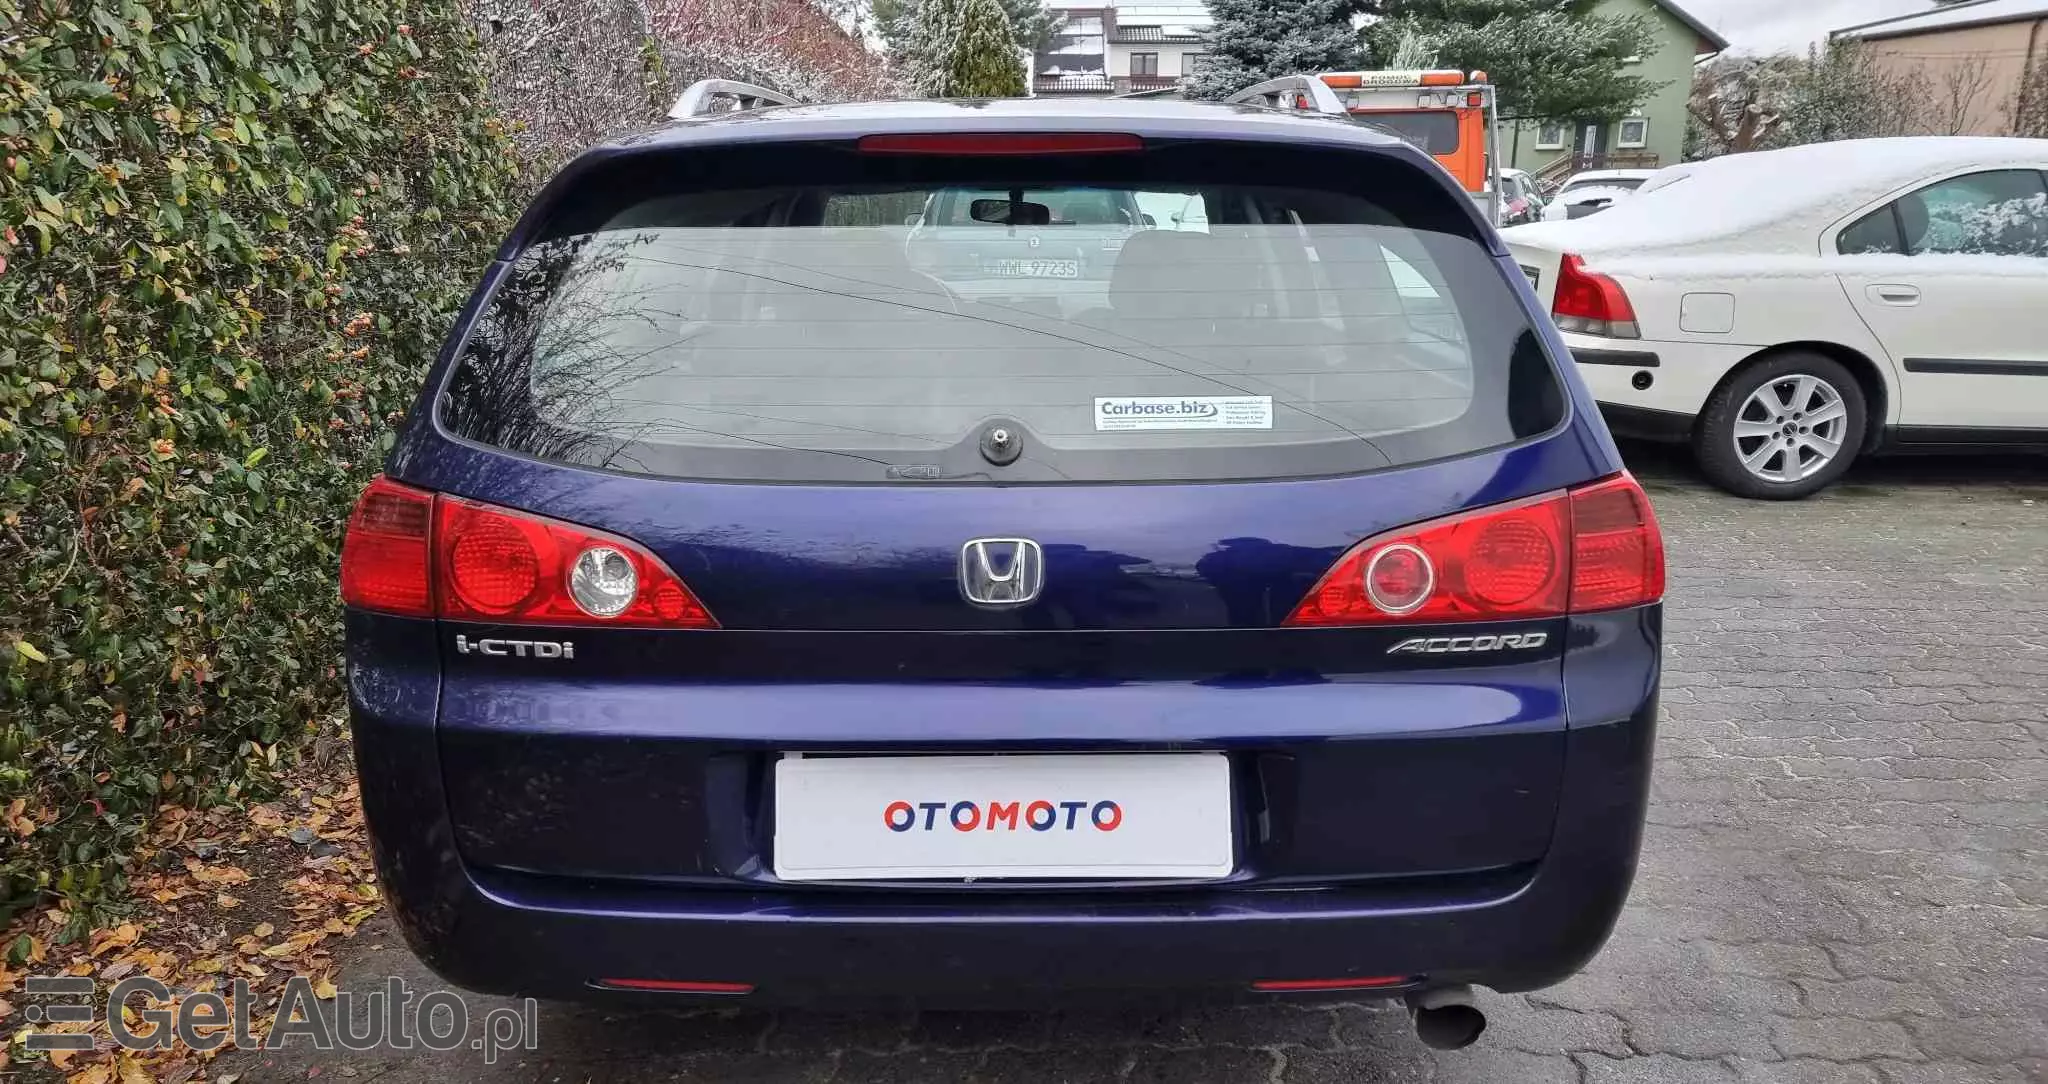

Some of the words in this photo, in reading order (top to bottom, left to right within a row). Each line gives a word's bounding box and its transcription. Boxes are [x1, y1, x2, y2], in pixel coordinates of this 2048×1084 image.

[1101, 401, 1209, 415] Carbase.biz
[1386, 632, 1548, 655] ACCORD
[884, 800, 1122, 832] OTOMOTO
